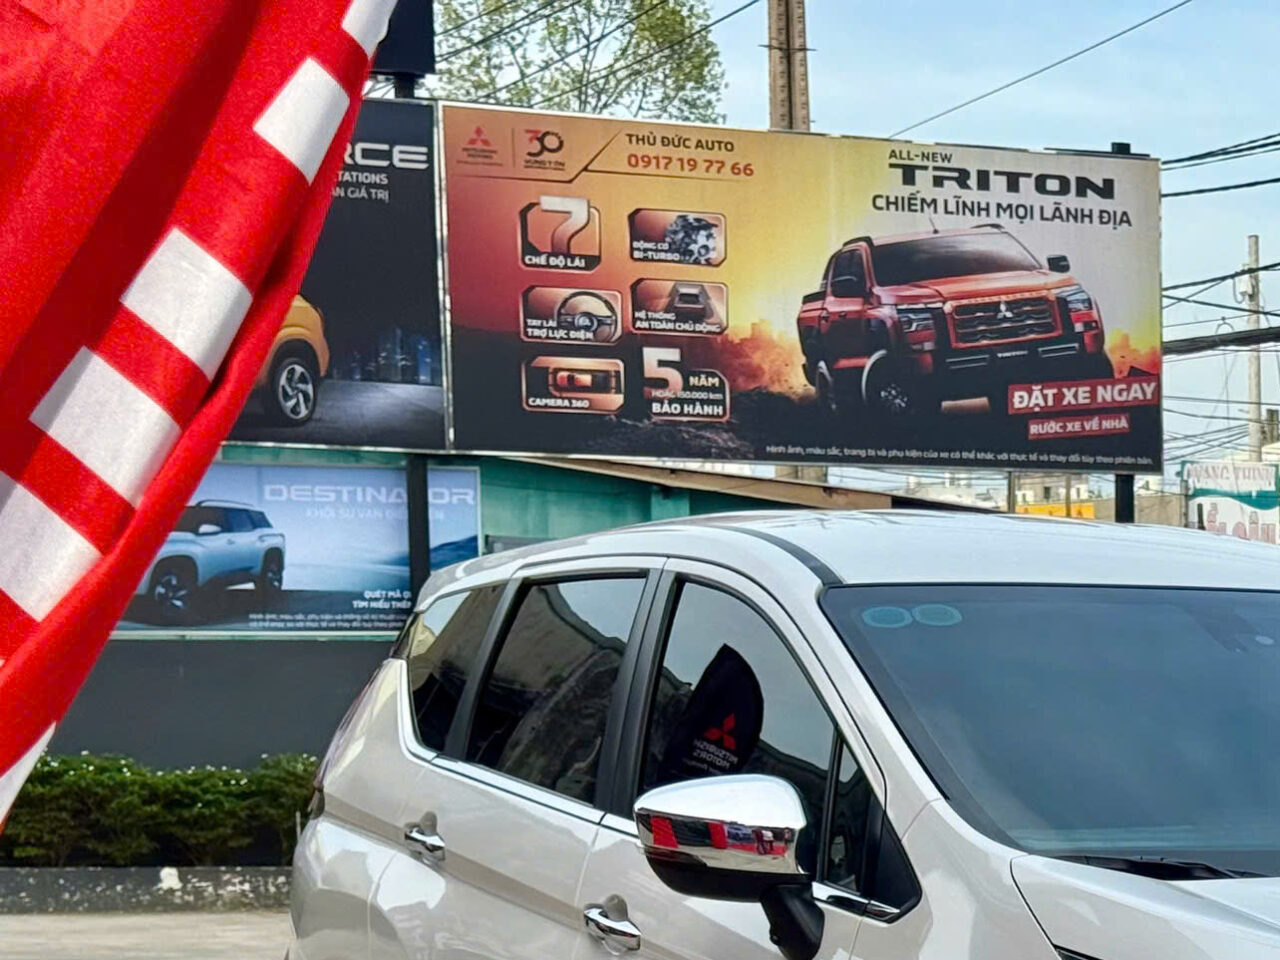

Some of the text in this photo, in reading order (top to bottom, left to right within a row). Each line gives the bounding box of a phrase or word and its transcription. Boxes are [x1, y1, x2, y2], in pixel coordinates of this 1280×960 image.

[626, 131, 735, 152] THỦ ĐỨC AUTO
[627, 153, 755, 177] 0917 19 77 66
[888, 149, 953, 163] ALL-NEW
[888, 163, 1115, 200] TRITON
[347, 185, 368, 199] GIÁ
[369, 188, 390, 204] TRỊ
[872, 189, 1132, 230] CHIẾM LĨNH MỌI LÃNH ĐỊA
[539, 195, 591, 255] 7
[524, 252, 586, 268] CHẾ ĐỘ LÁI
[633, 251, 680, 261] BI-TURBO
[549, 328, 568, 339] LỰC
[635, 320, 649, 329] AN
[650, 320, 674, 330] TOÀN
[675, 320, 694, 331] CHỦ
[642, 346, 684, 399] 5
[689, 375, 720, 387] NĂM
[528, 397, 590, 409] CAMERA 360
[1013, 382, 1157, 412] ĐẶT XE NGAY
[652, 402, 724, 416] BẢO HÀNH
[1030, 416, 1129, 435] RƯỚC XE VỀ NHÀ
[263, 484, 475, 505] DESTINAOR
